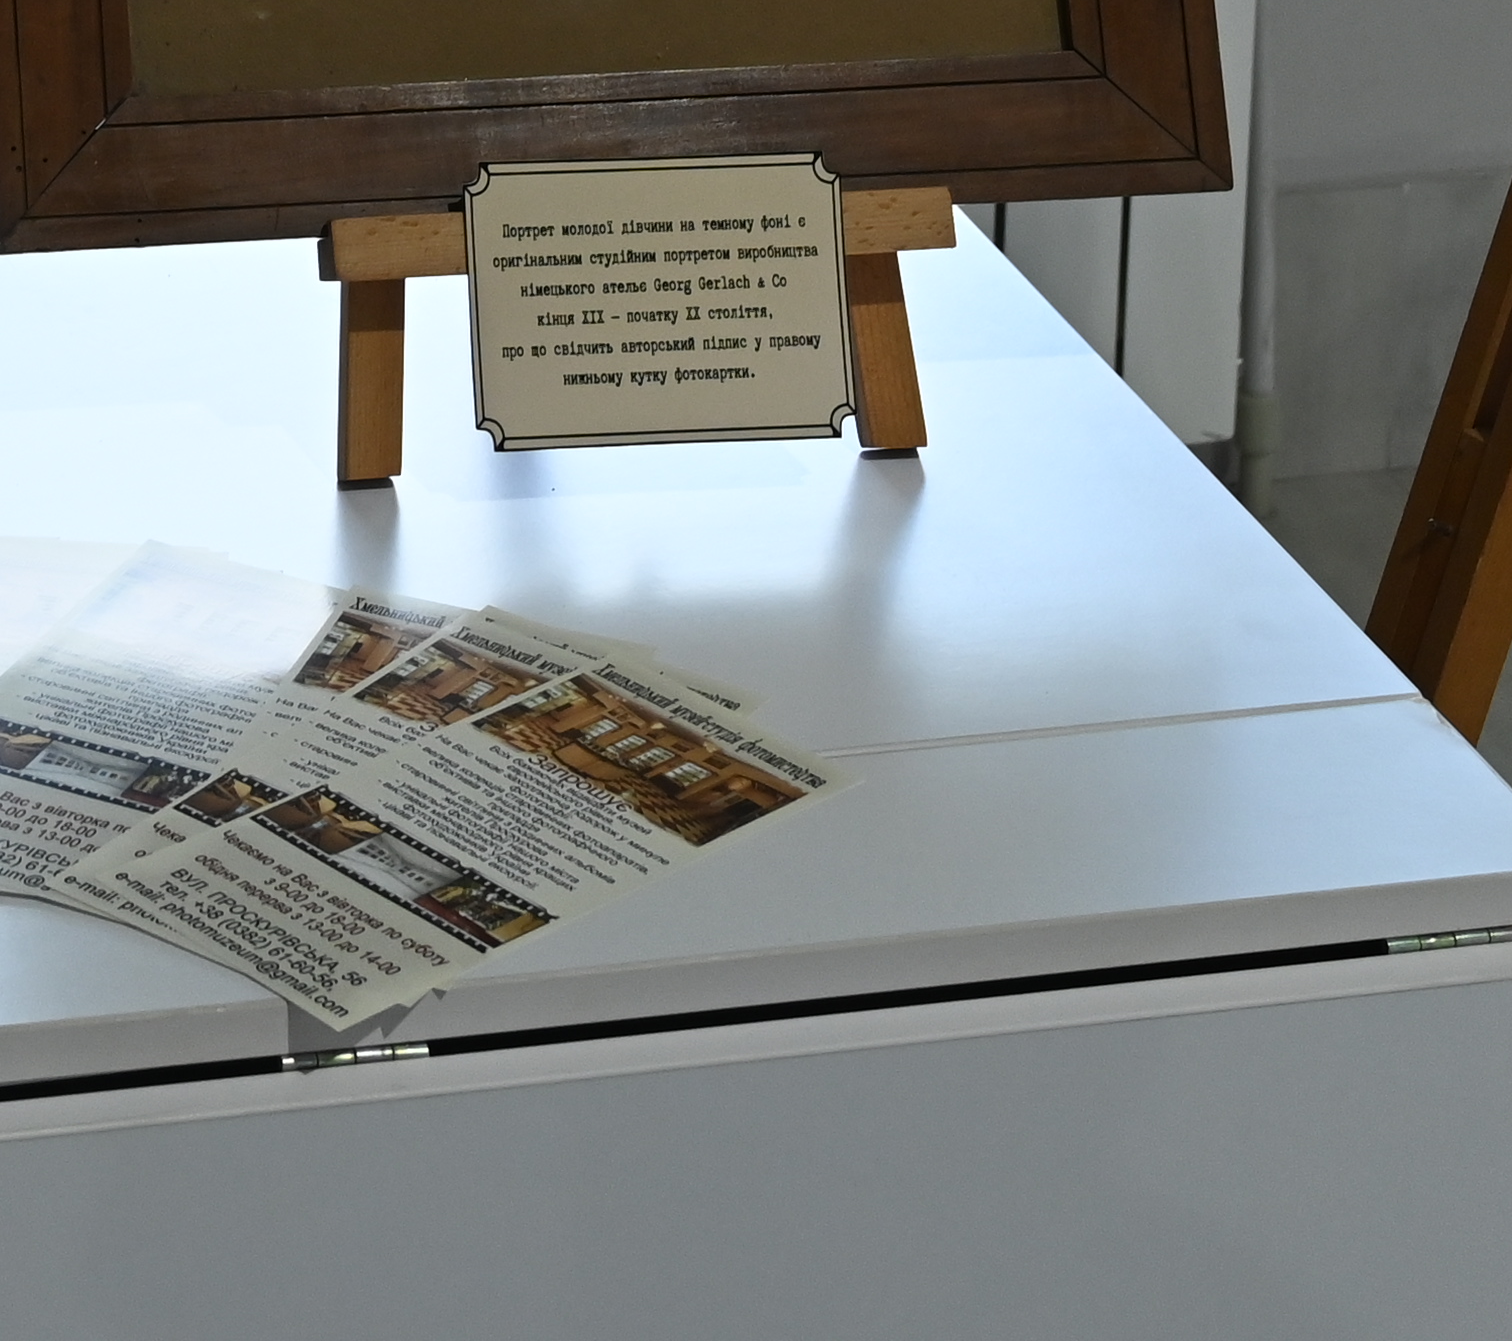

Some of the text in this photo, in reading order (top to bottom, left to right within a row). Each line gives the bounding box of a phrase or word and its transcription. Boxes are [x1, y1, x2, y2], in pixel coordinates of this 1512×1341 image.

[502, 213, 806, 242] Портрет молодої дівчини на темному фоні є
[492, 244, 819, 272] оригінальним студійним портретом виробництва
[520, 273, 787, 297] німецького ательє Georg Gerlach & Co
[536, 311, 575, 327] кінця
[581, 309, 605, 325] XIX
[626, 310, 678, 325] початку
[685, 305, 701, 321] XX
[707, 304, 773, 320] століття,
[501, 334, 821, 361] про що свідчить авторський підпис у правому
[562, 366, 755, 387] нижньому кутку фотокартки.
[528, 754, 632, 813] Запрошує
[169, 867, 368, 986] ВУЛ. ПРОСКУРІВСЬКА, 56
[114, 872, 349, 1018] e-mail: photomuzeum@gmail.com
